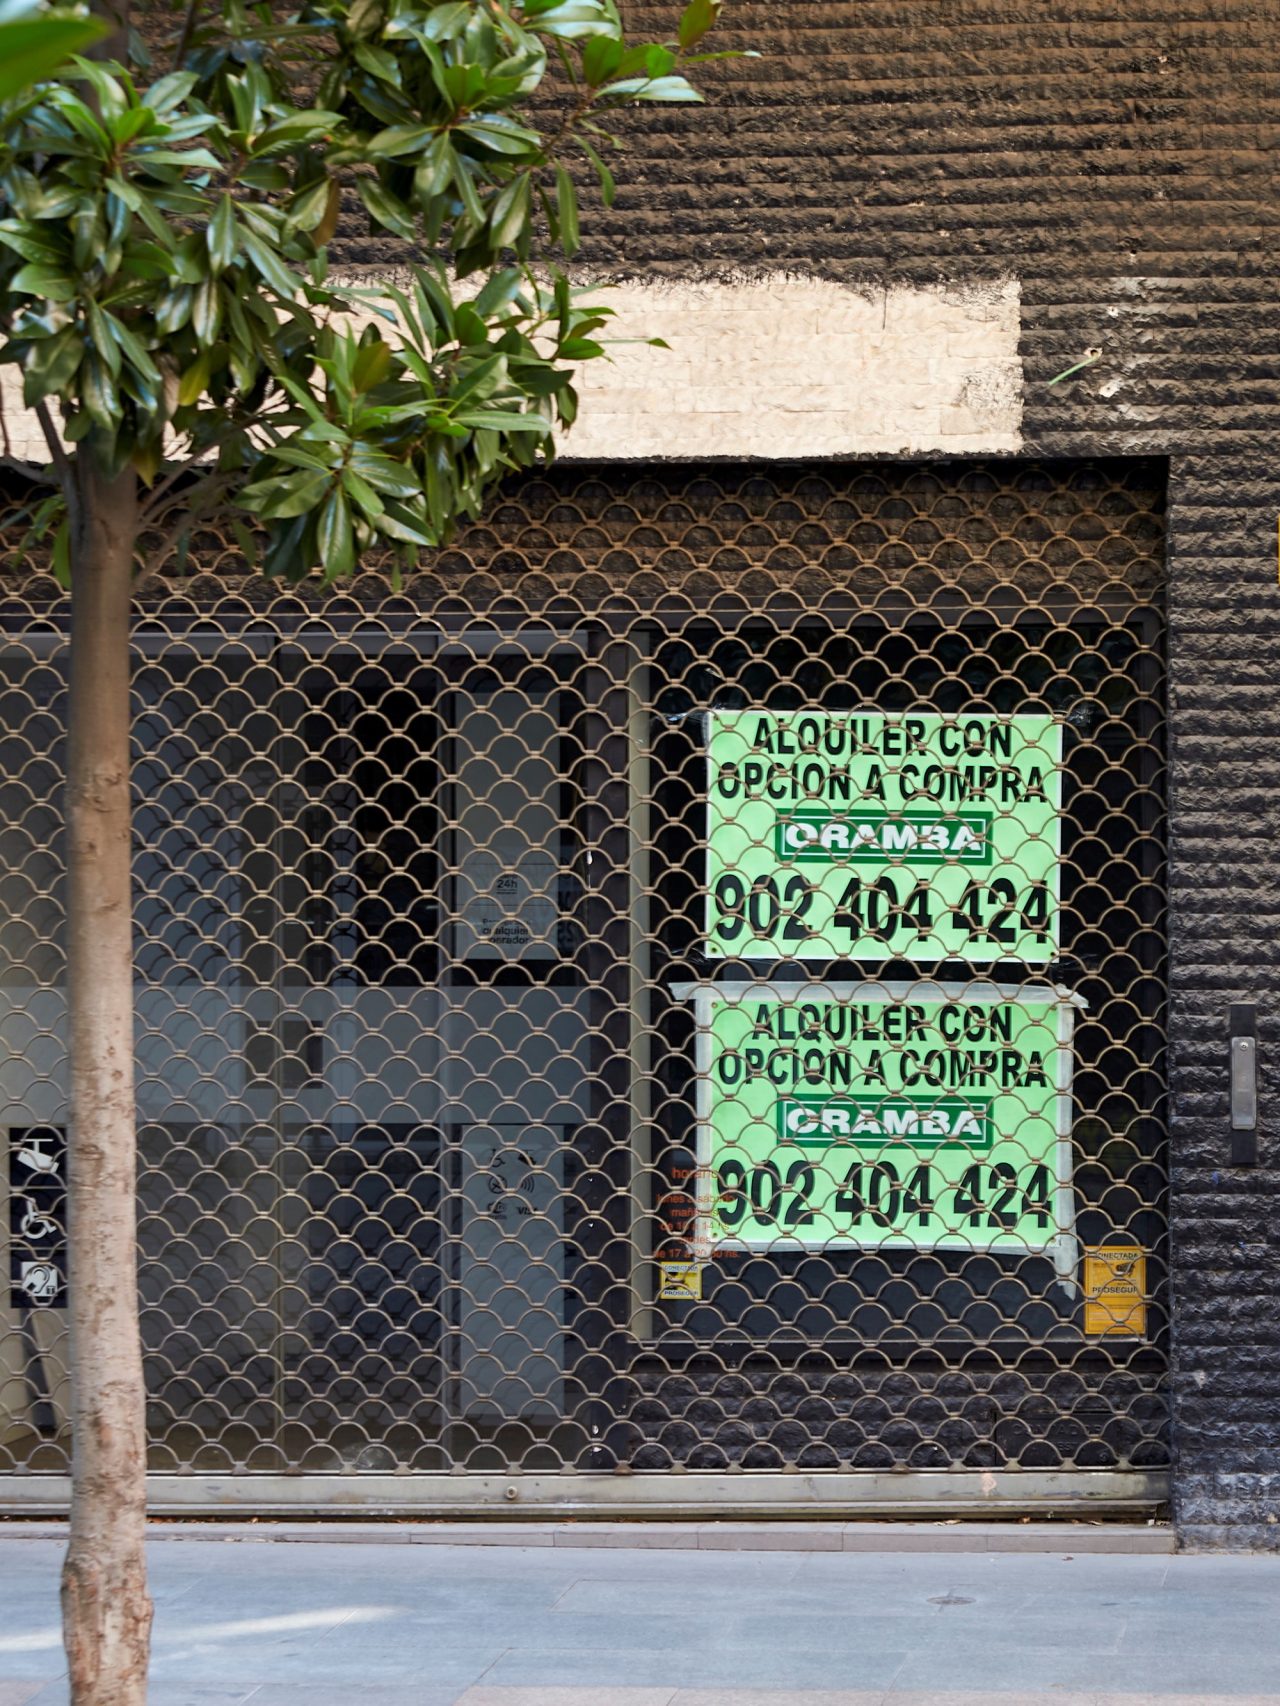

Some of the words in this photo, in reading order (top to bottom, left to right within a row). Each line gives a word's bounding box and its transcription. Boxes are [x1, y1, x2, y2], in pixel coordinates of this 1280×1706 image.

[754, 717, 927, 757] ALQUILER
[939, 719, 1012, 758] CON
[717, 762, 850, 800] OPCION
[864, 765, 887, 801] A
[899, 764, 1046, 803] COMPRA
[715, 874, 813, 941] 902
[833, 875, 933, 942] 404
[951, 877, 1051, 944] 424
[752, 1003, 927, 1041] ALQUILER
[939, 1005, 1012, 1042] CON
[718, 1047, 851, 1086] OPCION
[864, 1049, 886, 1086] A
[899, 1049, 1047, 1088] COMPRA
[716, 1159, 815, 1226] 902
[834, 1160, 933, 1228] 404
[953, 1162, 1052, 1229] 424
